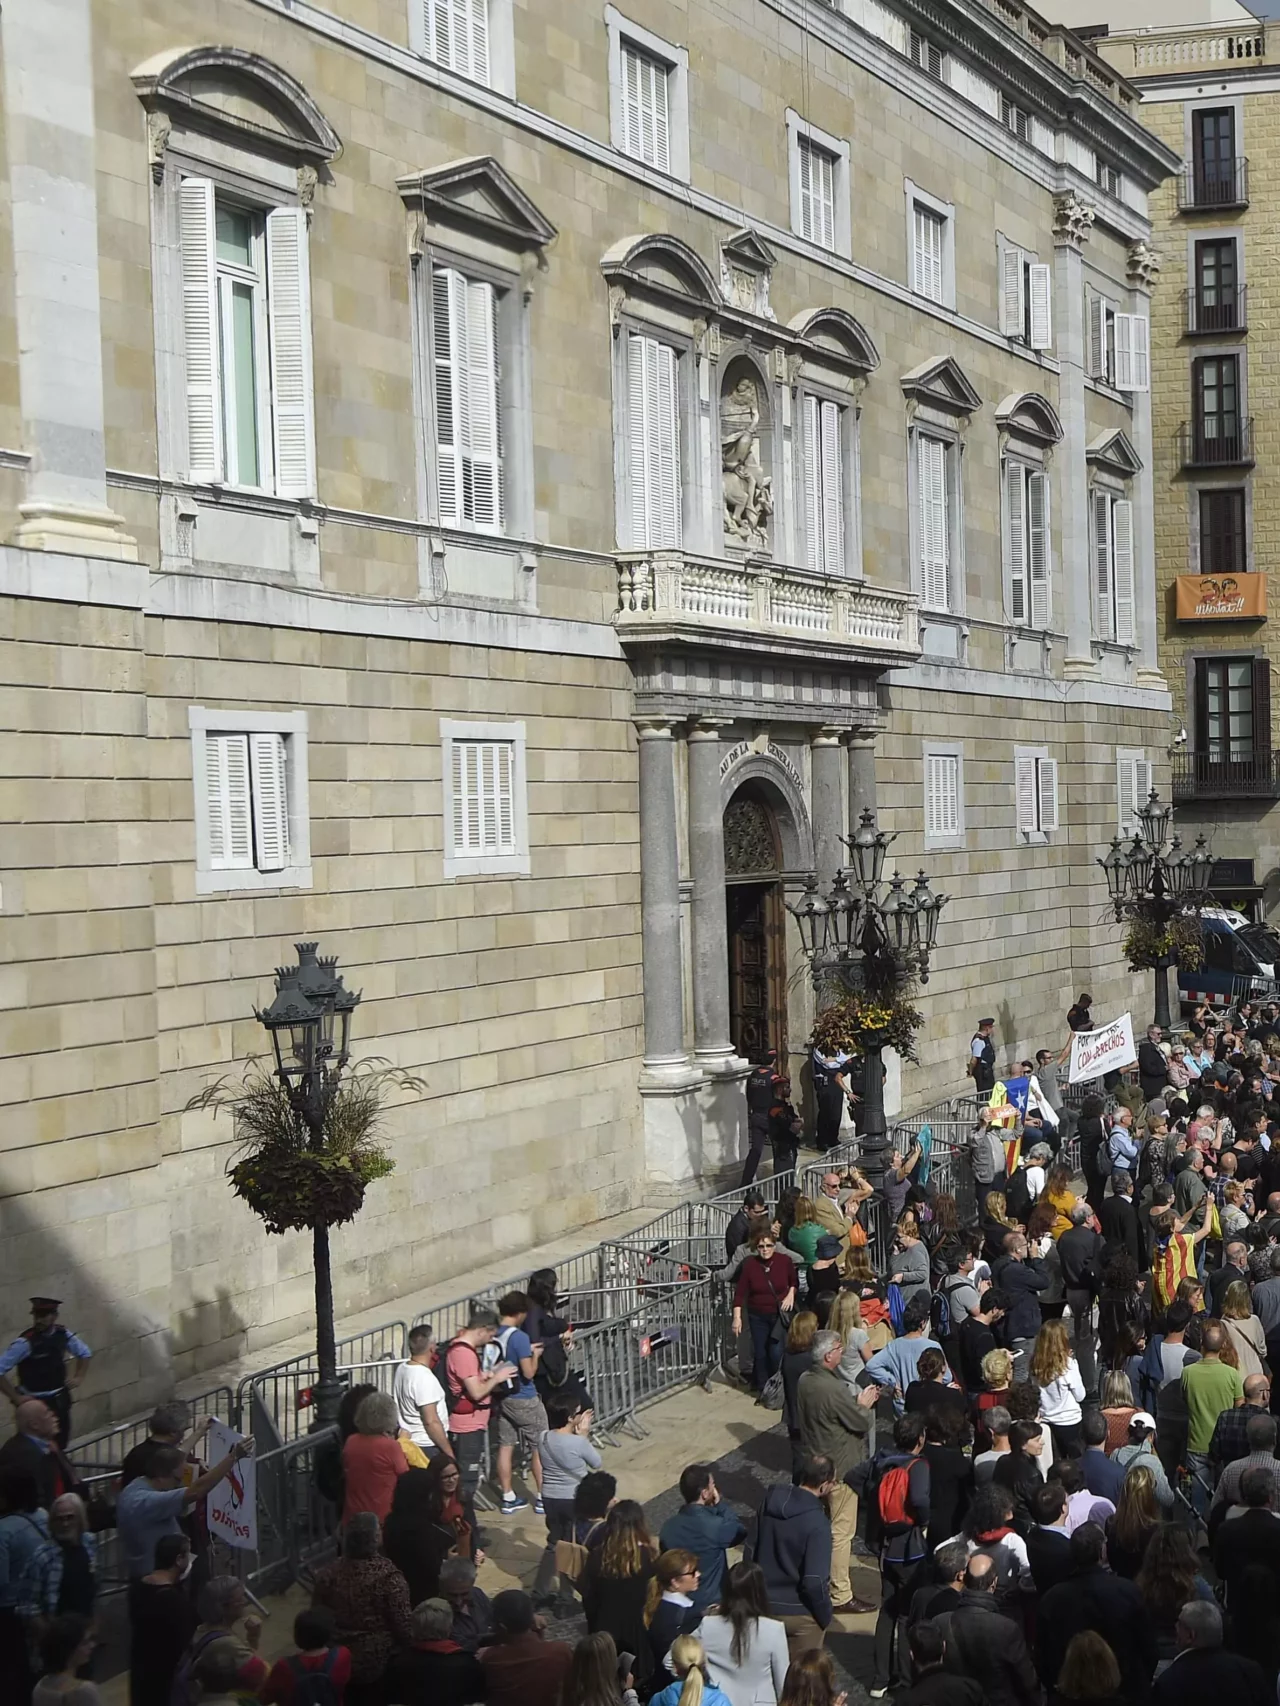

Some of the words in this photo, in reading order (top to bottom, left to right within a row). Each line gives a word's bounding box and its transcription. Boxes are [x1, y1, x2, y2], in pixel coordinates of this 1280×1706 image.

[730, 747, 740, 765] DE
[740, 742, 750, 754] LA
[1077, 1050, 1092, 1070] CON
